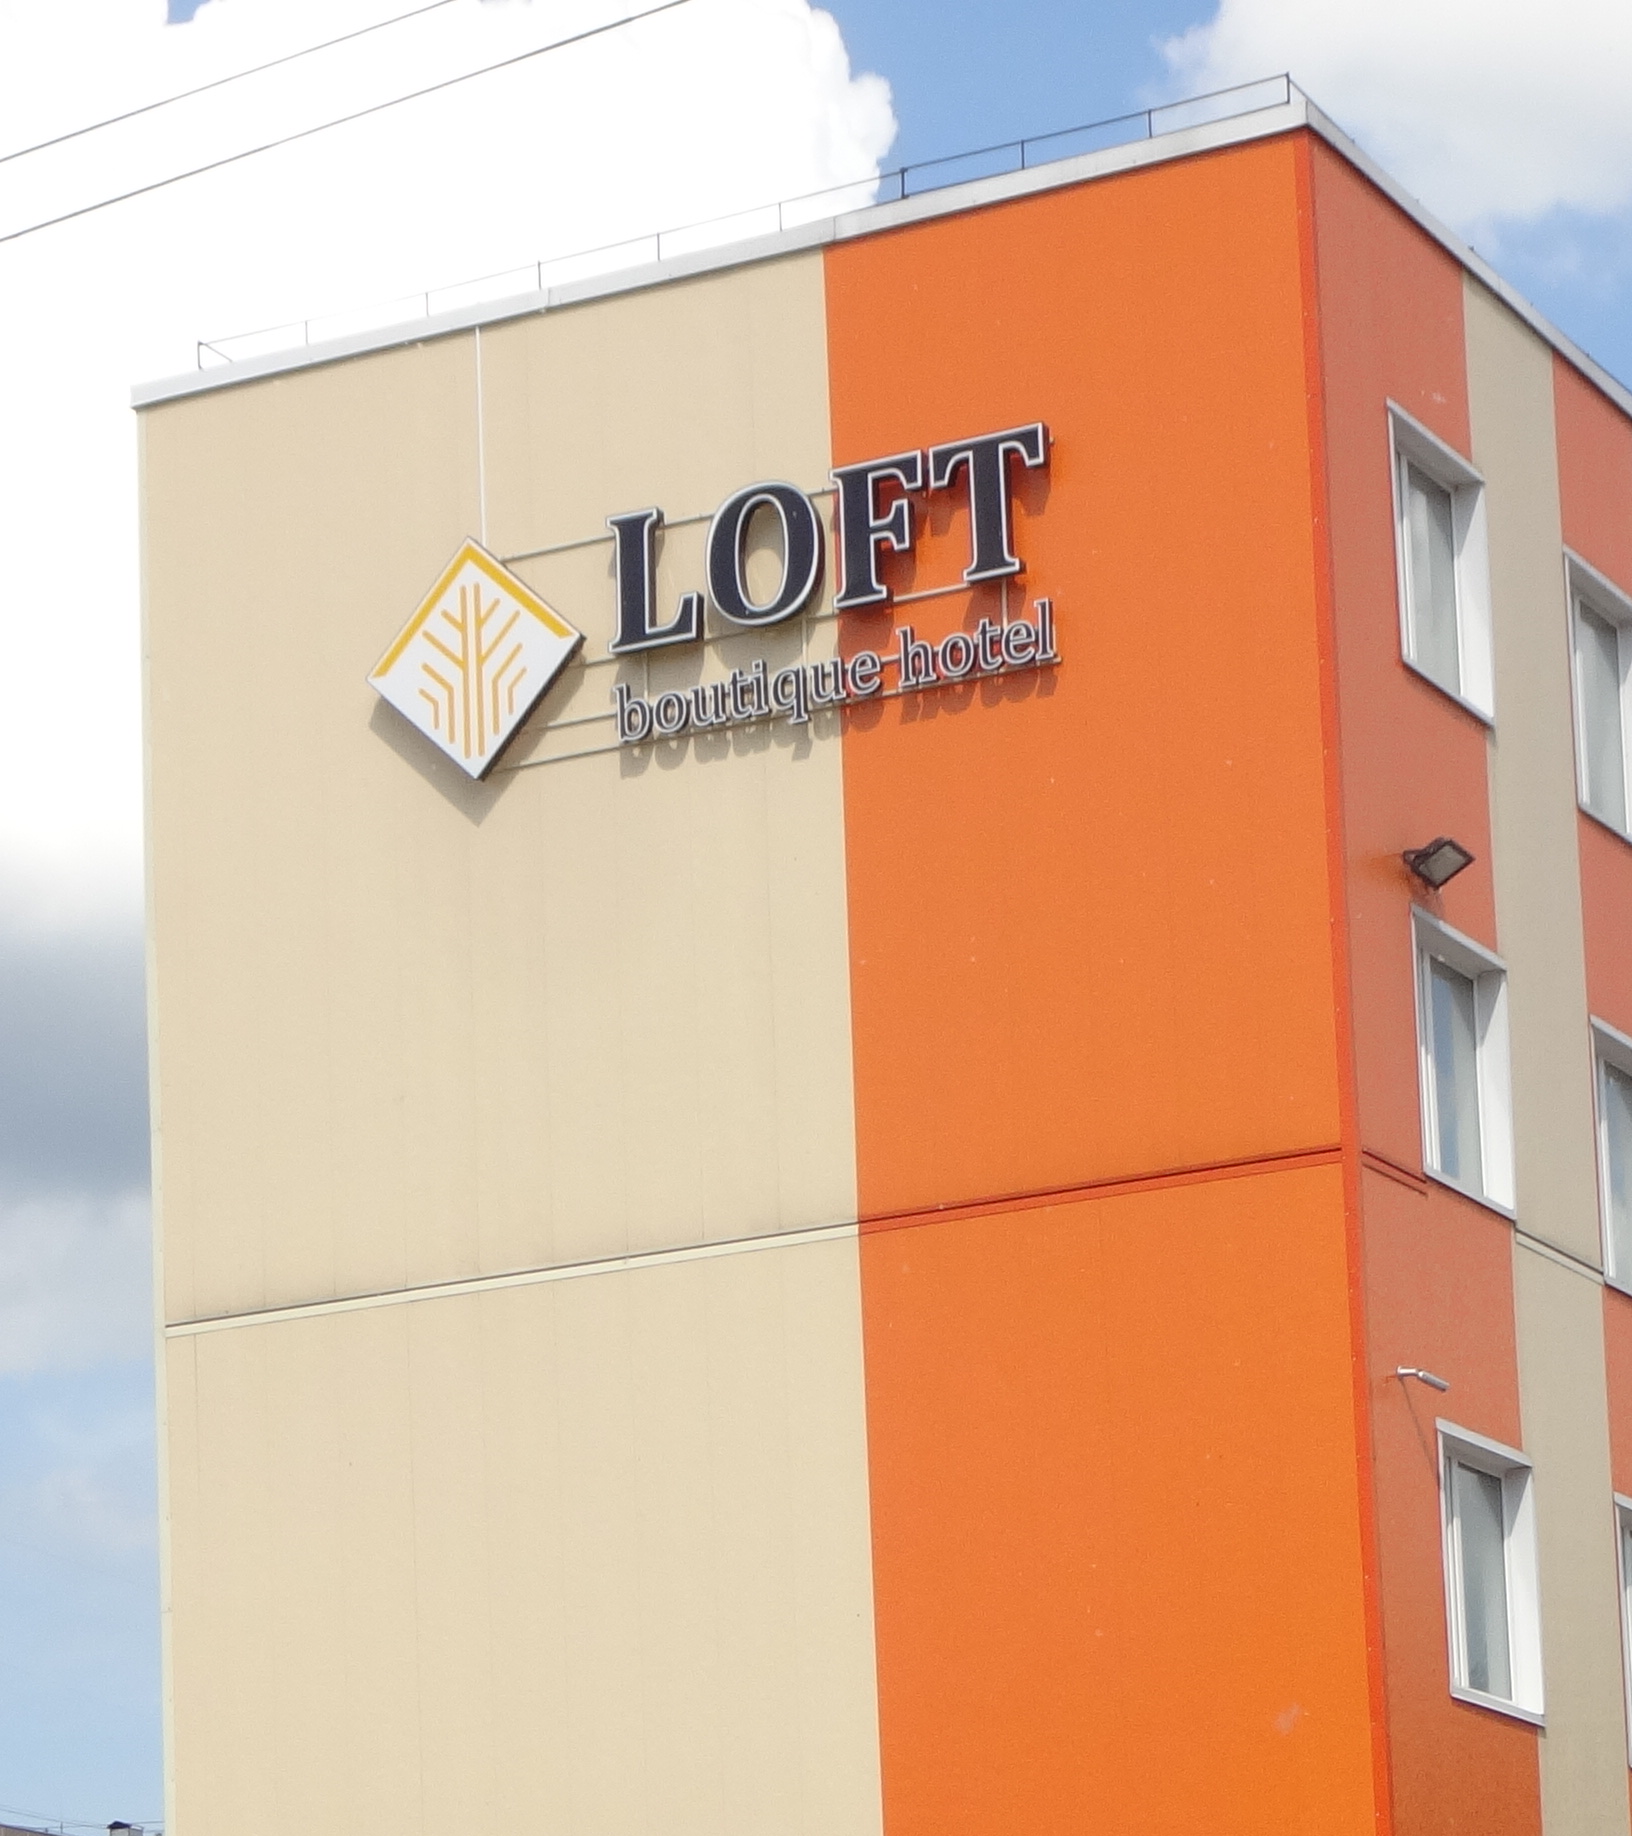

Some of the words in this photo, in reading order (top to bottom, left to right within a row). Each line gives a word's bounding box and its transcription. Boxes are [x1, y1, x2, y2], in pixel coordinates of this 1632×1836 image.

[605, 421, 1049, 655] LOFT
[614, 648, 882, 742] boutique
[898, 598, 1057, 697] hotel
